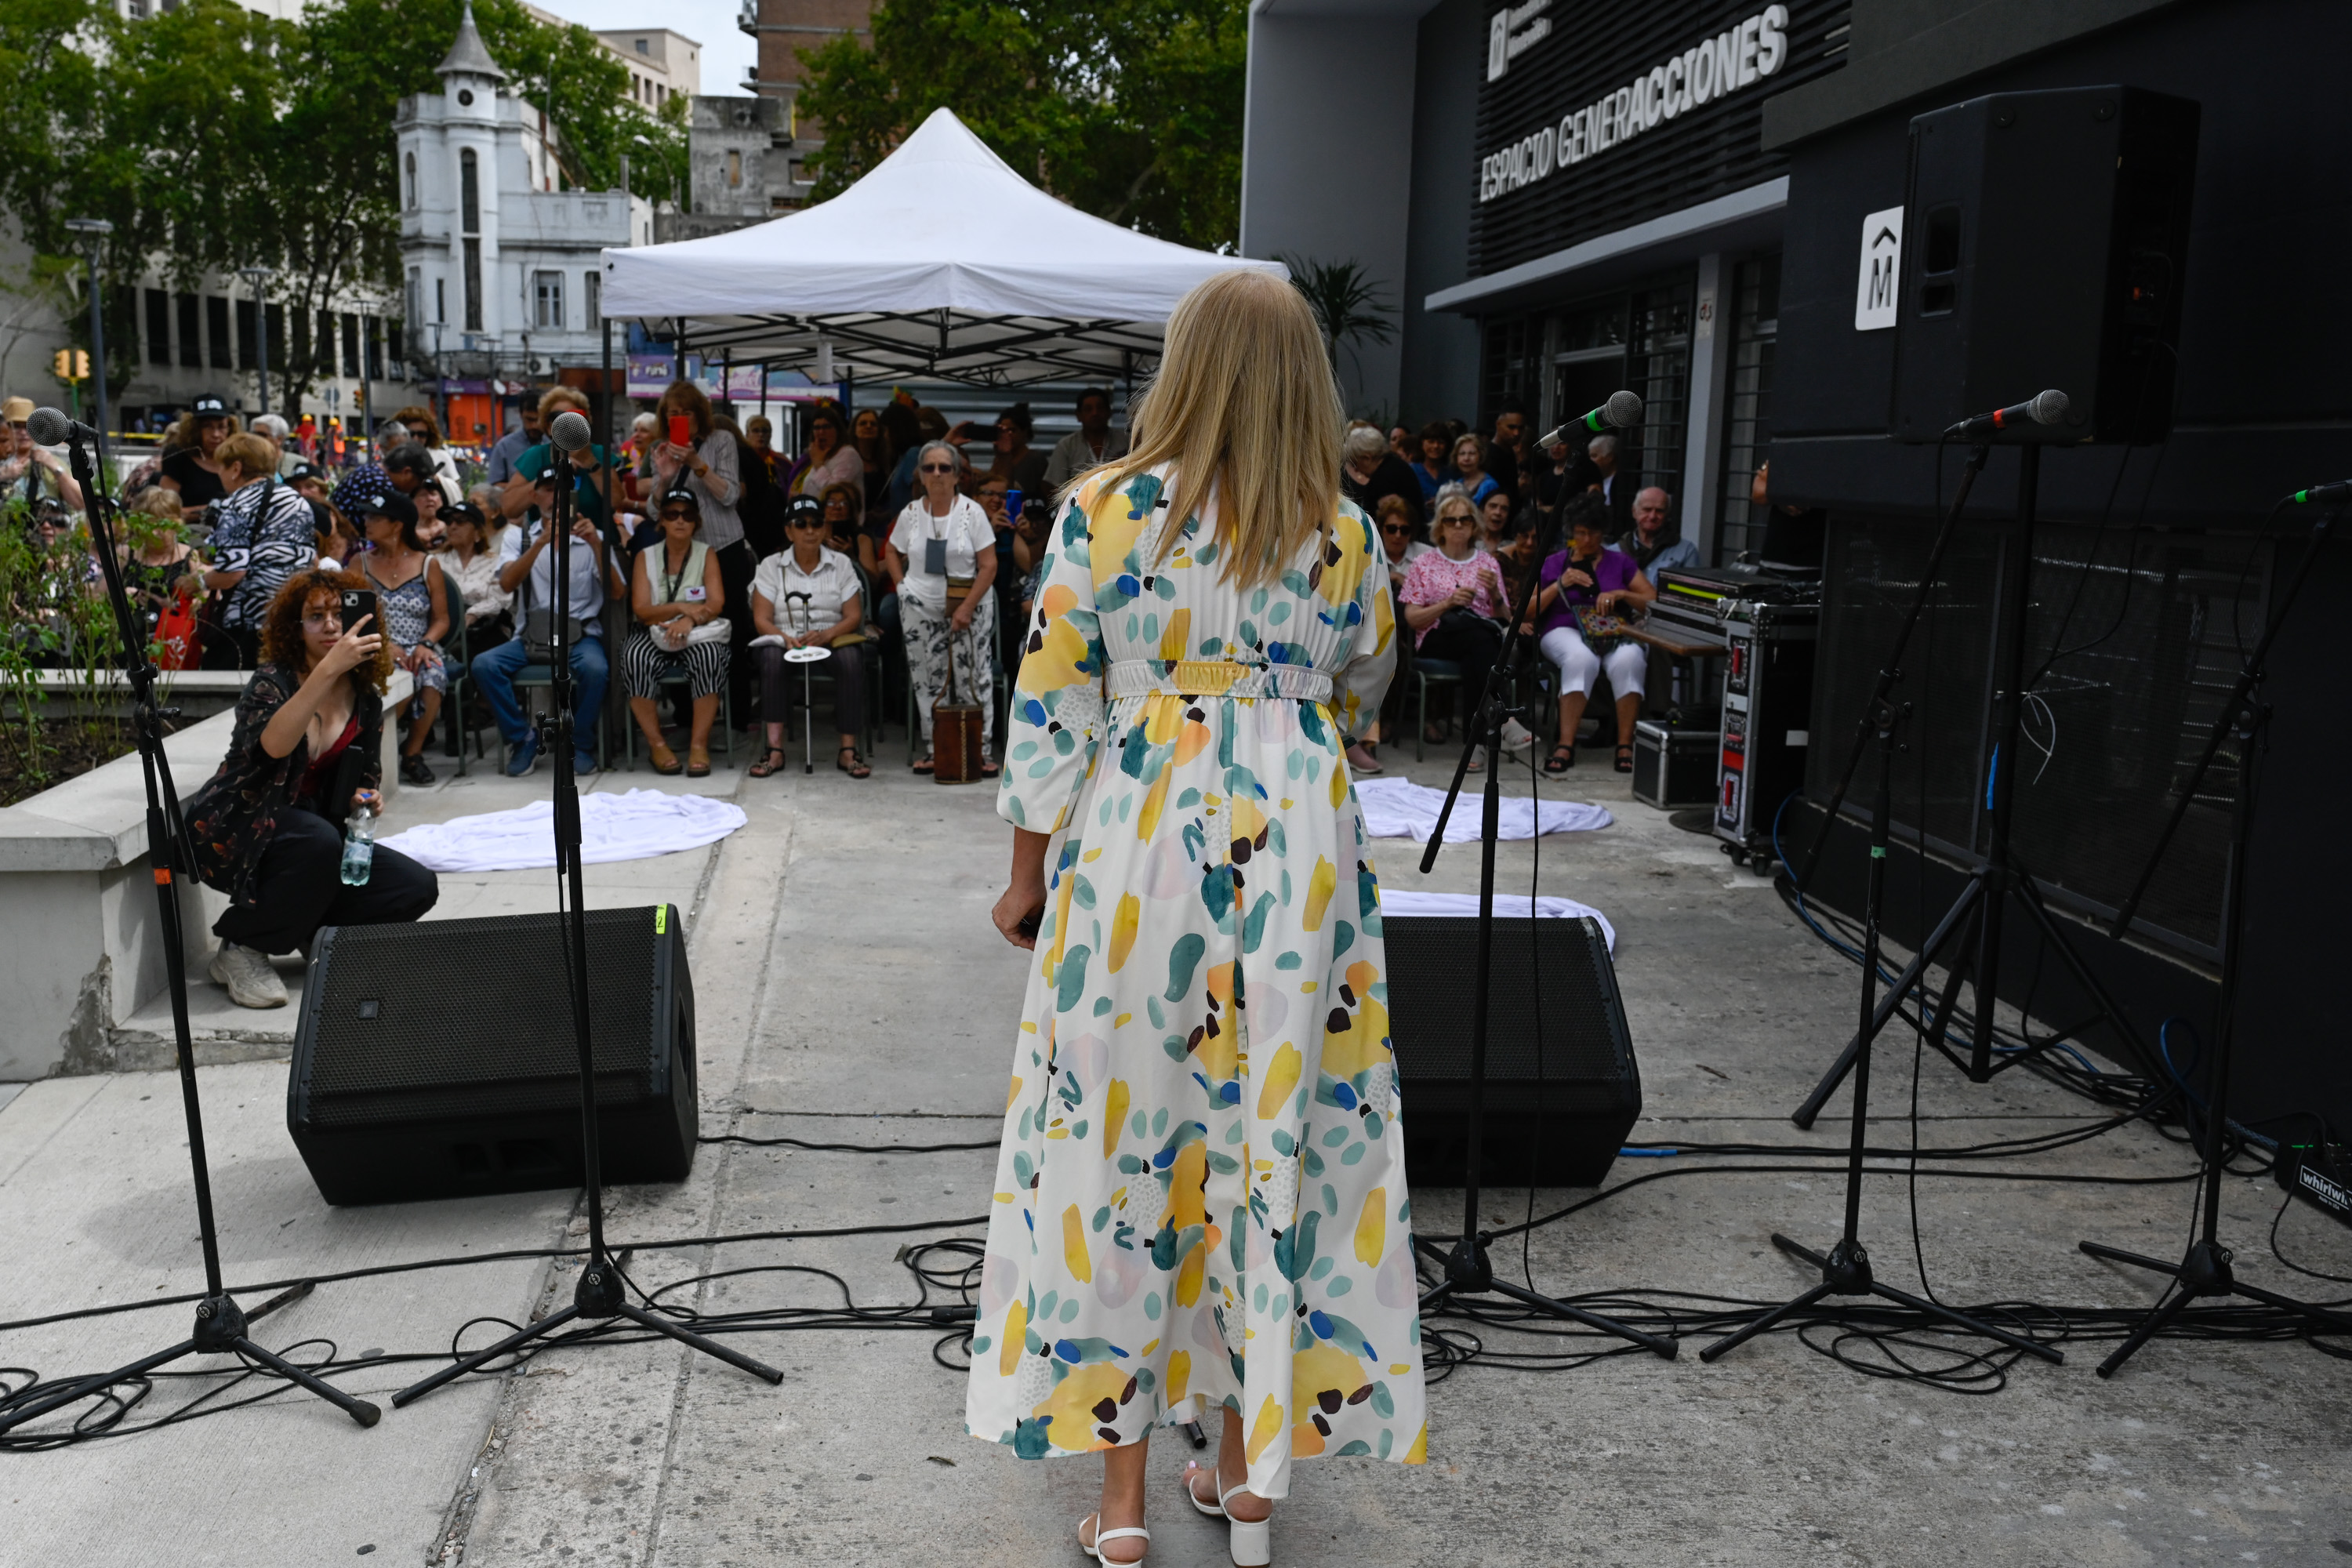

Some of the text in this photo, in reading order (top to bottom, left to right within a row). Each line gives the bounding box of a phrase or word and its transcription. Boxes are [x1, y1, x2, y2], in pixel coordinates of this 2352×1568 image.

[1480, 126, 1556, 203] ESPACIO
[1557, 4, 1789, 169] GENERACCIONES
[657, 916, 664, 928] 2
